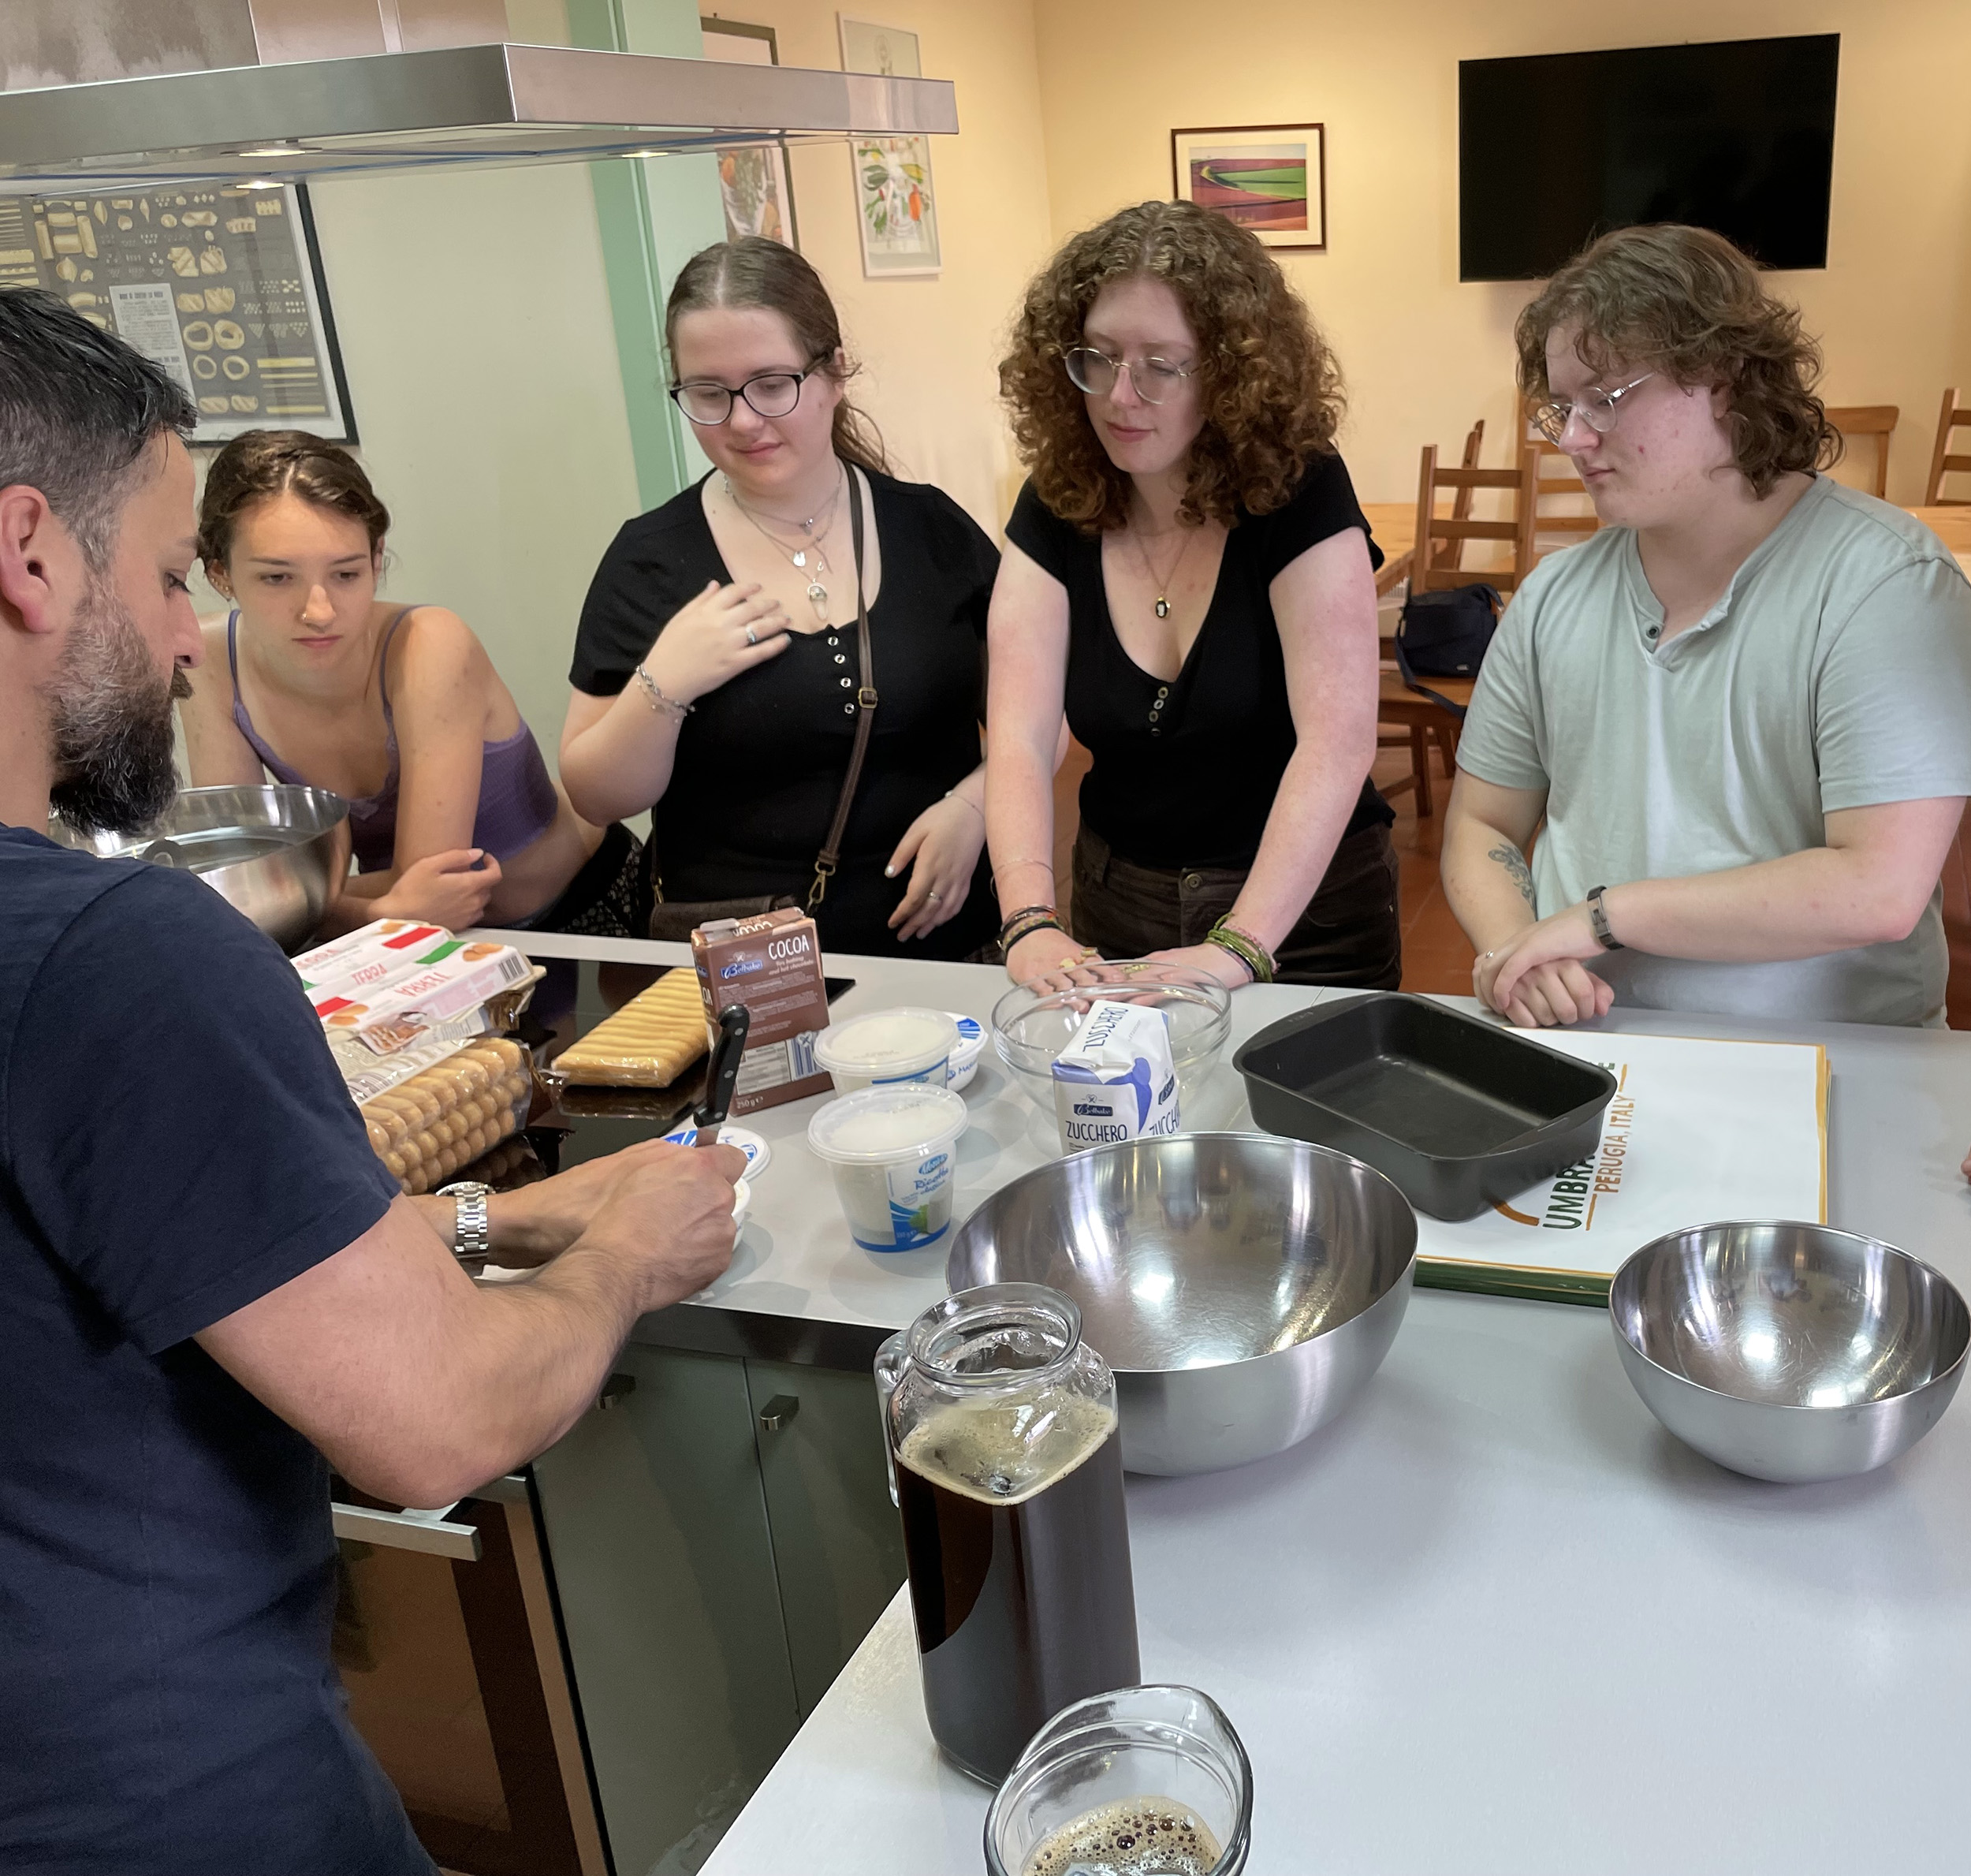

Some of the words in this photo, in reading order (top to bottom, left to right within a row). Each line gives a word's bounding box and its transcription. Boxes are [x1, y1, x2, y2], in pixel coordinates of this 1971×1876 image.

[768, 934, 810, 960] COCOA
[1609, 1095, 1635, 1128] ITALY
[1065, 1120, 1127, 1143] ZUCCHERO
[1593, 1132, 1632, 1193] PERUGIA,
